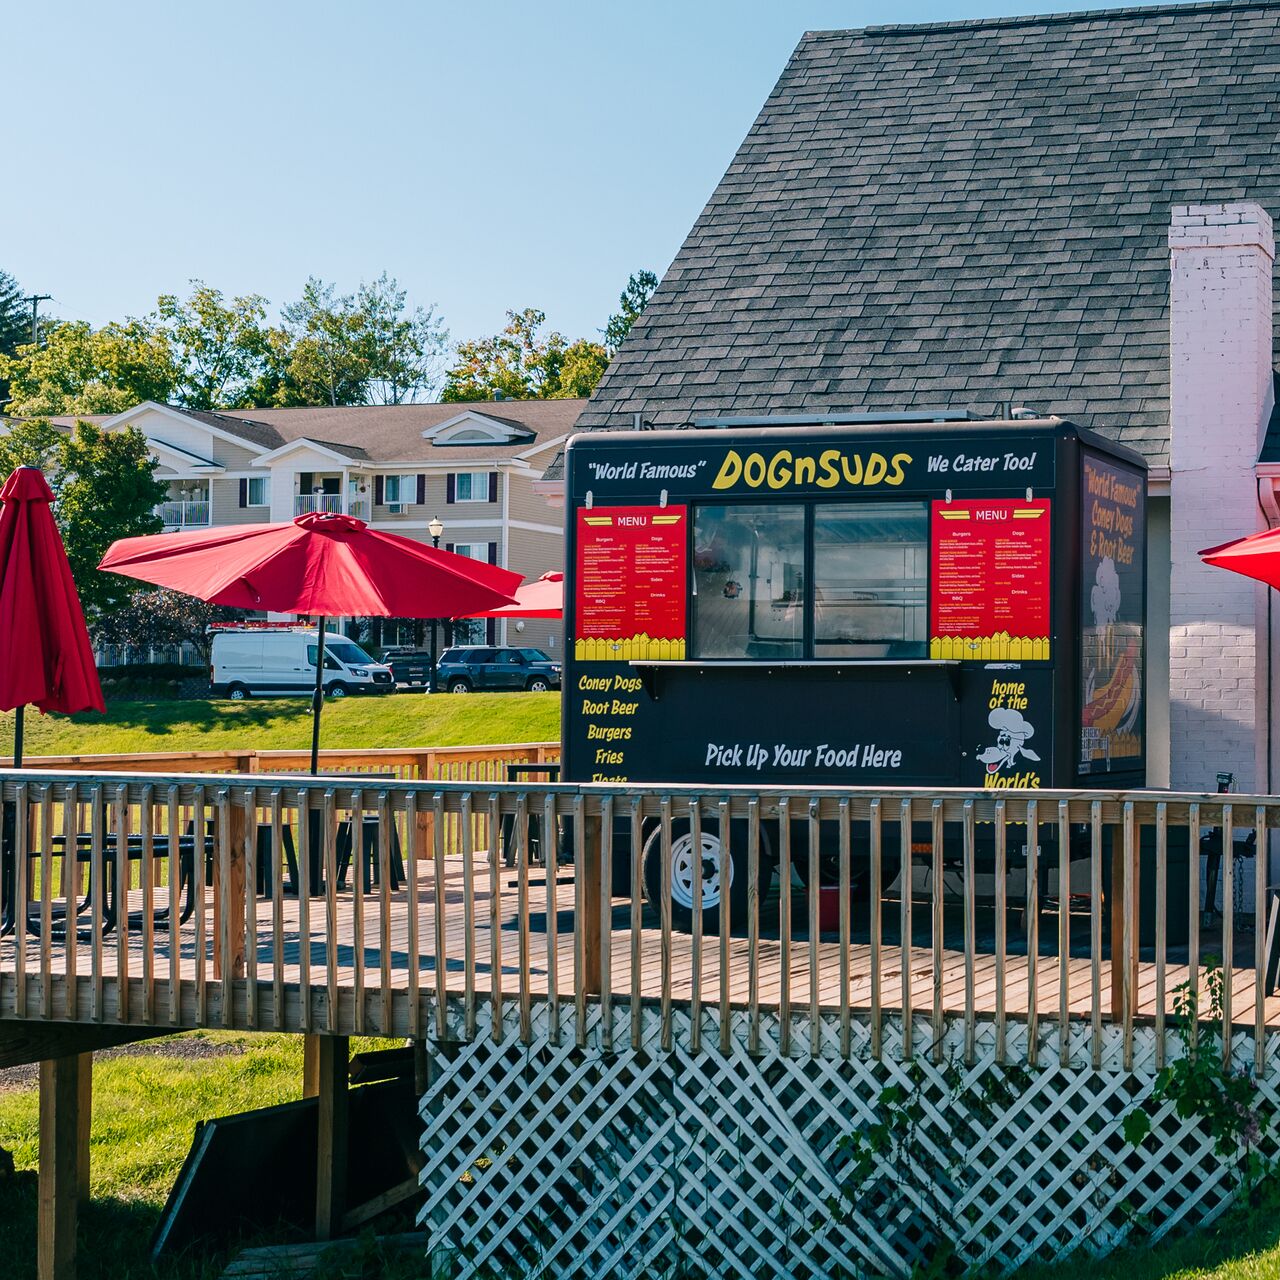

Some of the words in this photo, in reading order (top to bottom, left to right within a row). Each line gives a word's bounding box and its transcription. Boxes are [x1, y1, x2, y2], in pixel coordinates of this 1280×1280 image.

[927, 455, 949, 472] We
[952, 454, 999, 472] Cater
[1003, 452, 1037, 471] Too!
[617, 516, 647, 526] MENU
[975, 510, 1008, 520] MENU
[1091, 499, 1115, 533] Coney
[1116, 506, 1134, 539] Dogs
[1098, 531, 1117, 559] Root
[1117, 537, 1135, 565] Beer
[578, 675, 612, 692] Coney
[614, 675, 642, 692] Dogs
[991, 679, 1025, 695] home
[582, 700, 609, 714] Root
[611, 700, 639, 714] Beer
[989, 694, 1005, 709] of
[1008, 694, 1028, 709] the
[587, 724, 632, 741] Burgers
[595, 749, 624, 764] Fries
[705, 743, 743, 766] Pick
[746, 744, 769, 770] Up
[772, 744, 812, 767] Your
[814, 744, 860, 767] Food
[861, 744, 902, 768] Here
